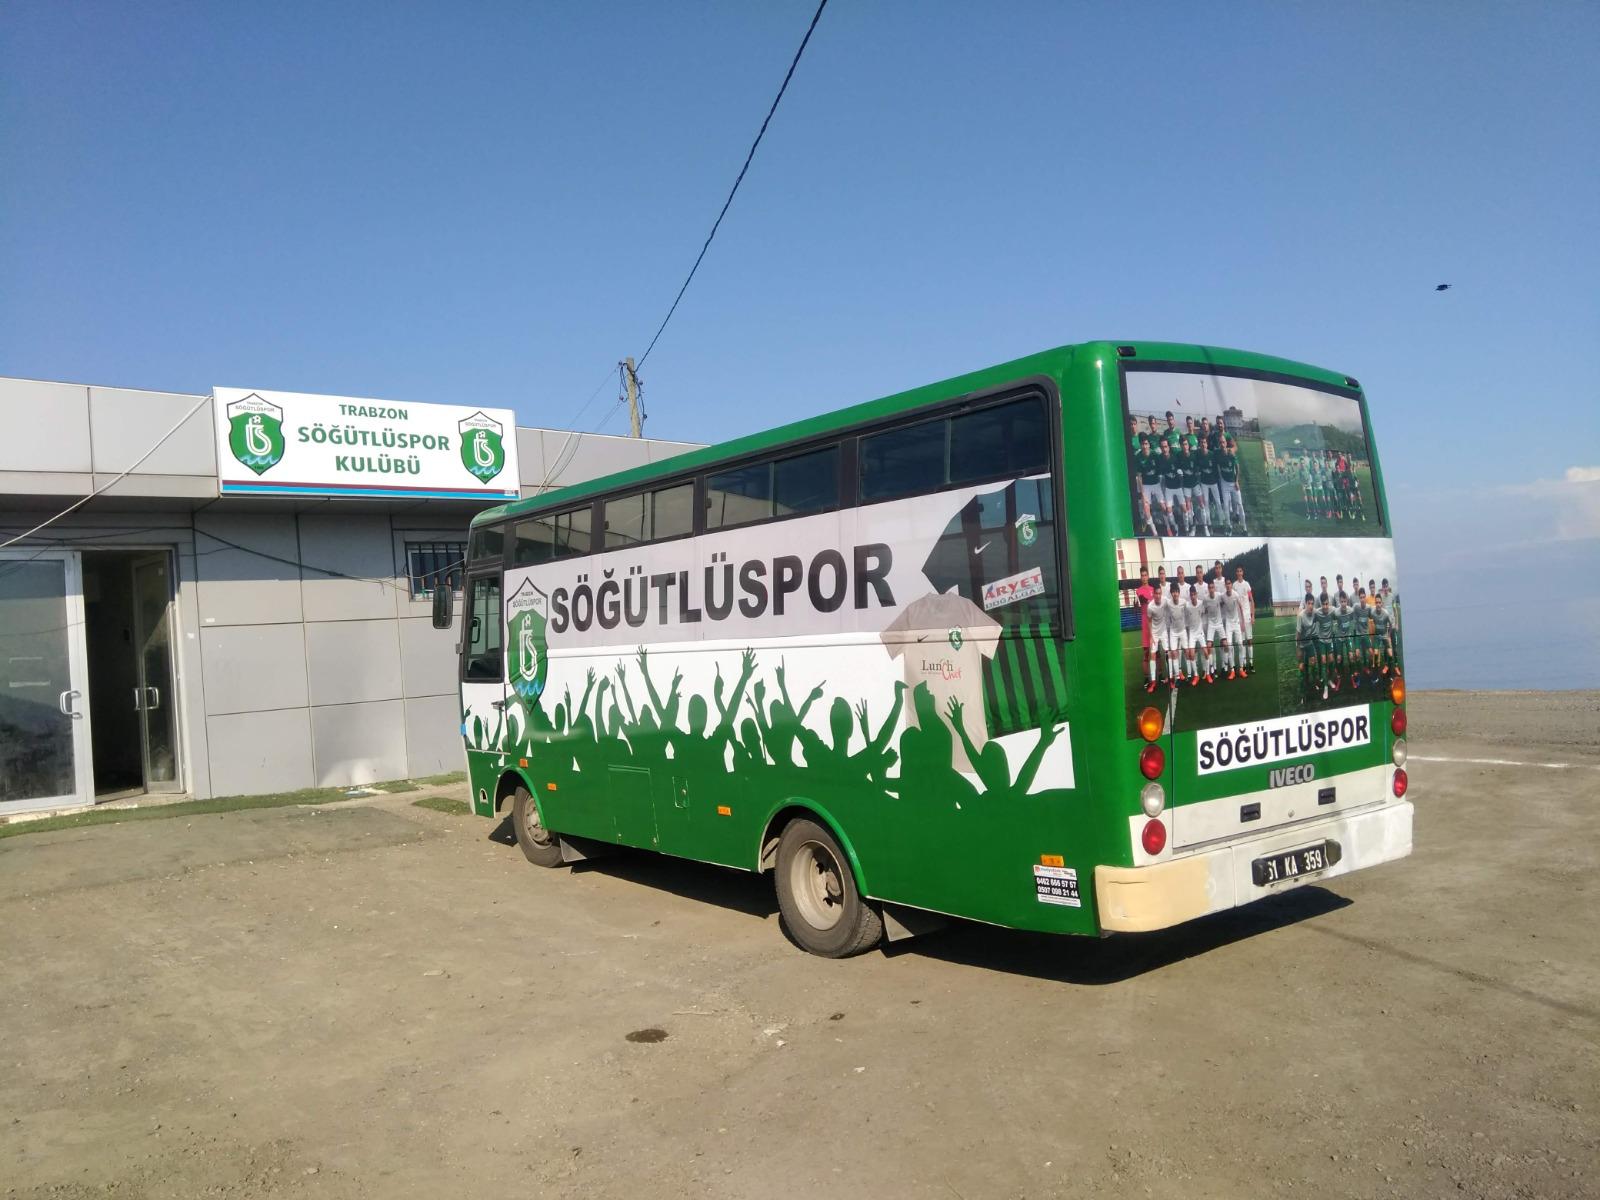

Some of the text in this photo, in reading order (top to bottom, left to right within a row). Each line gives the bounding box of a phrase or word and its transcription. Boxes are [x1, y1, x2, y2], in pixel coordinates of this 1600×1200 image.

[339, 404, 408, 420] TRABZON
[298, 424, 450, 451] SÖĞÜTLÜSPOR
[335, 454, 421, 475] KULÜBÜ
[551, 543, 896, 634] SÖĞÜTLÜSPOR
[1200, 715, 1368, 770] SÖĞÜTLÜSPOR
[1270, 764, 1314, 788] IVECO
[1284, 855, 1298, 876] KA
[1303, 849, 1323, 871] 359
